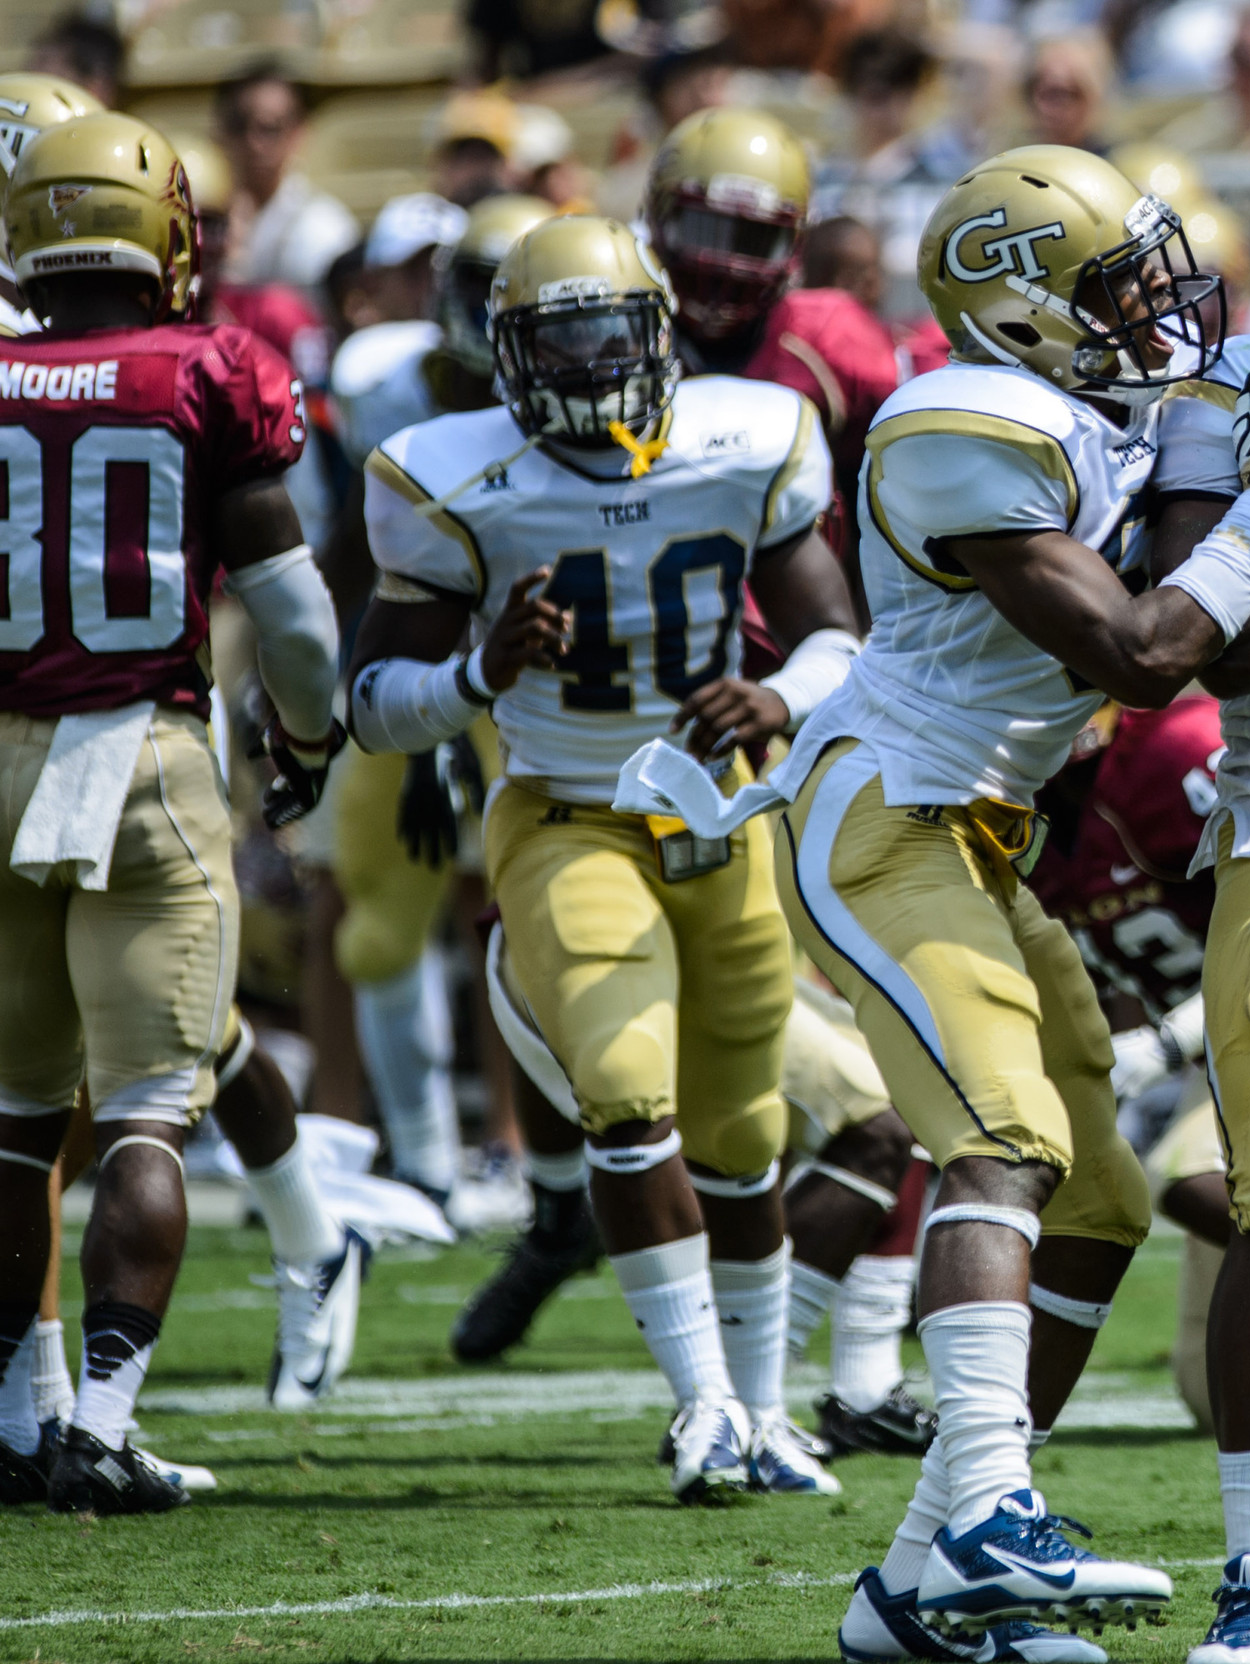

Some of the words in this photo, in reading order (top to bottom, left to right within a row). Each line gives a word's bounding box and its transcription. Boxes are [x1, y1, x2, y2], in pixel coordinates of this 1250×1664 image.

[32, 251, 113, 273] PHOENIX
[945, 206, 1066, 285] GT
[0, 360, 119, 400] MOORE
[705, 436, 744, 450] ACC
[1112, 435, 1156, 468] TECH
[599, 502, 650, 526] TECH
[540, 528, 748, 715] 40
